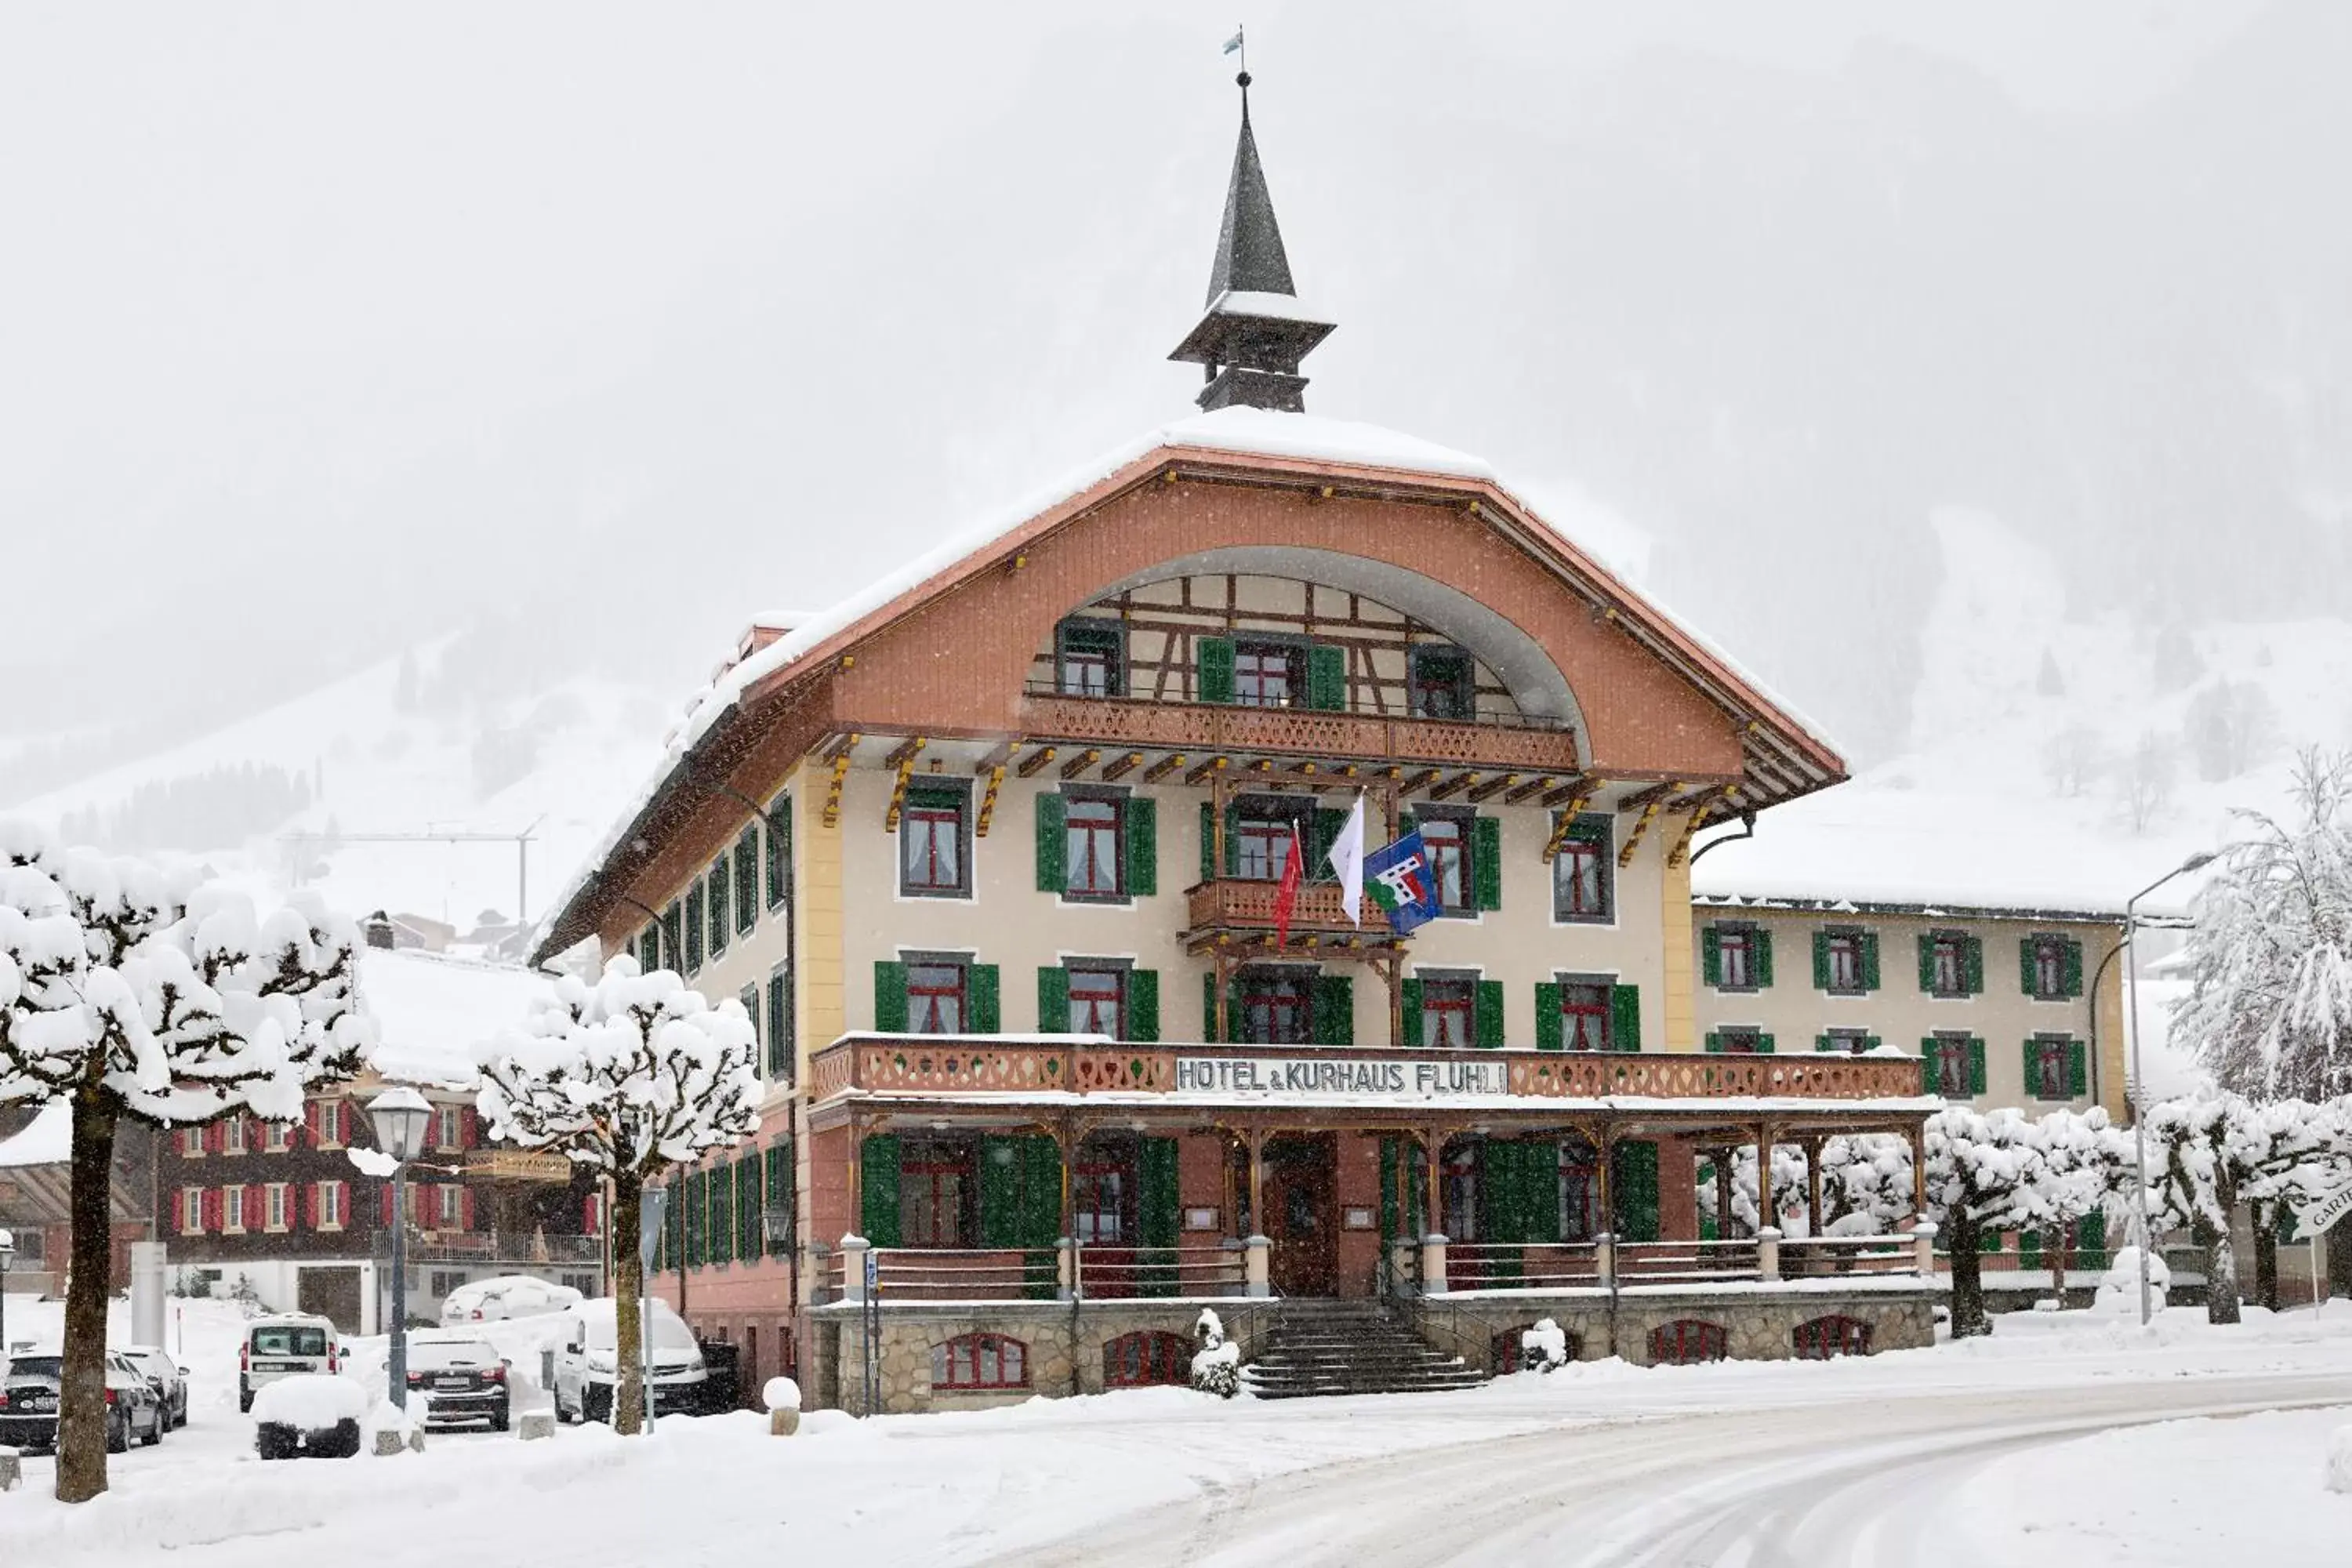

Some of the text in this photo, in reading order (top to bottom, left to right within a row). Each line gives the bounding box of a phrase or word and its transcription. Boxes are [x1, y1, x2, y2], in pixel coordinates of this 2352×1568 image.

[1178, 1061, 1268, 1091] HOTEL
[1270, 1069, 1285, 1091] &
[1286, 1062, 1406, 1092] KURHAUS
